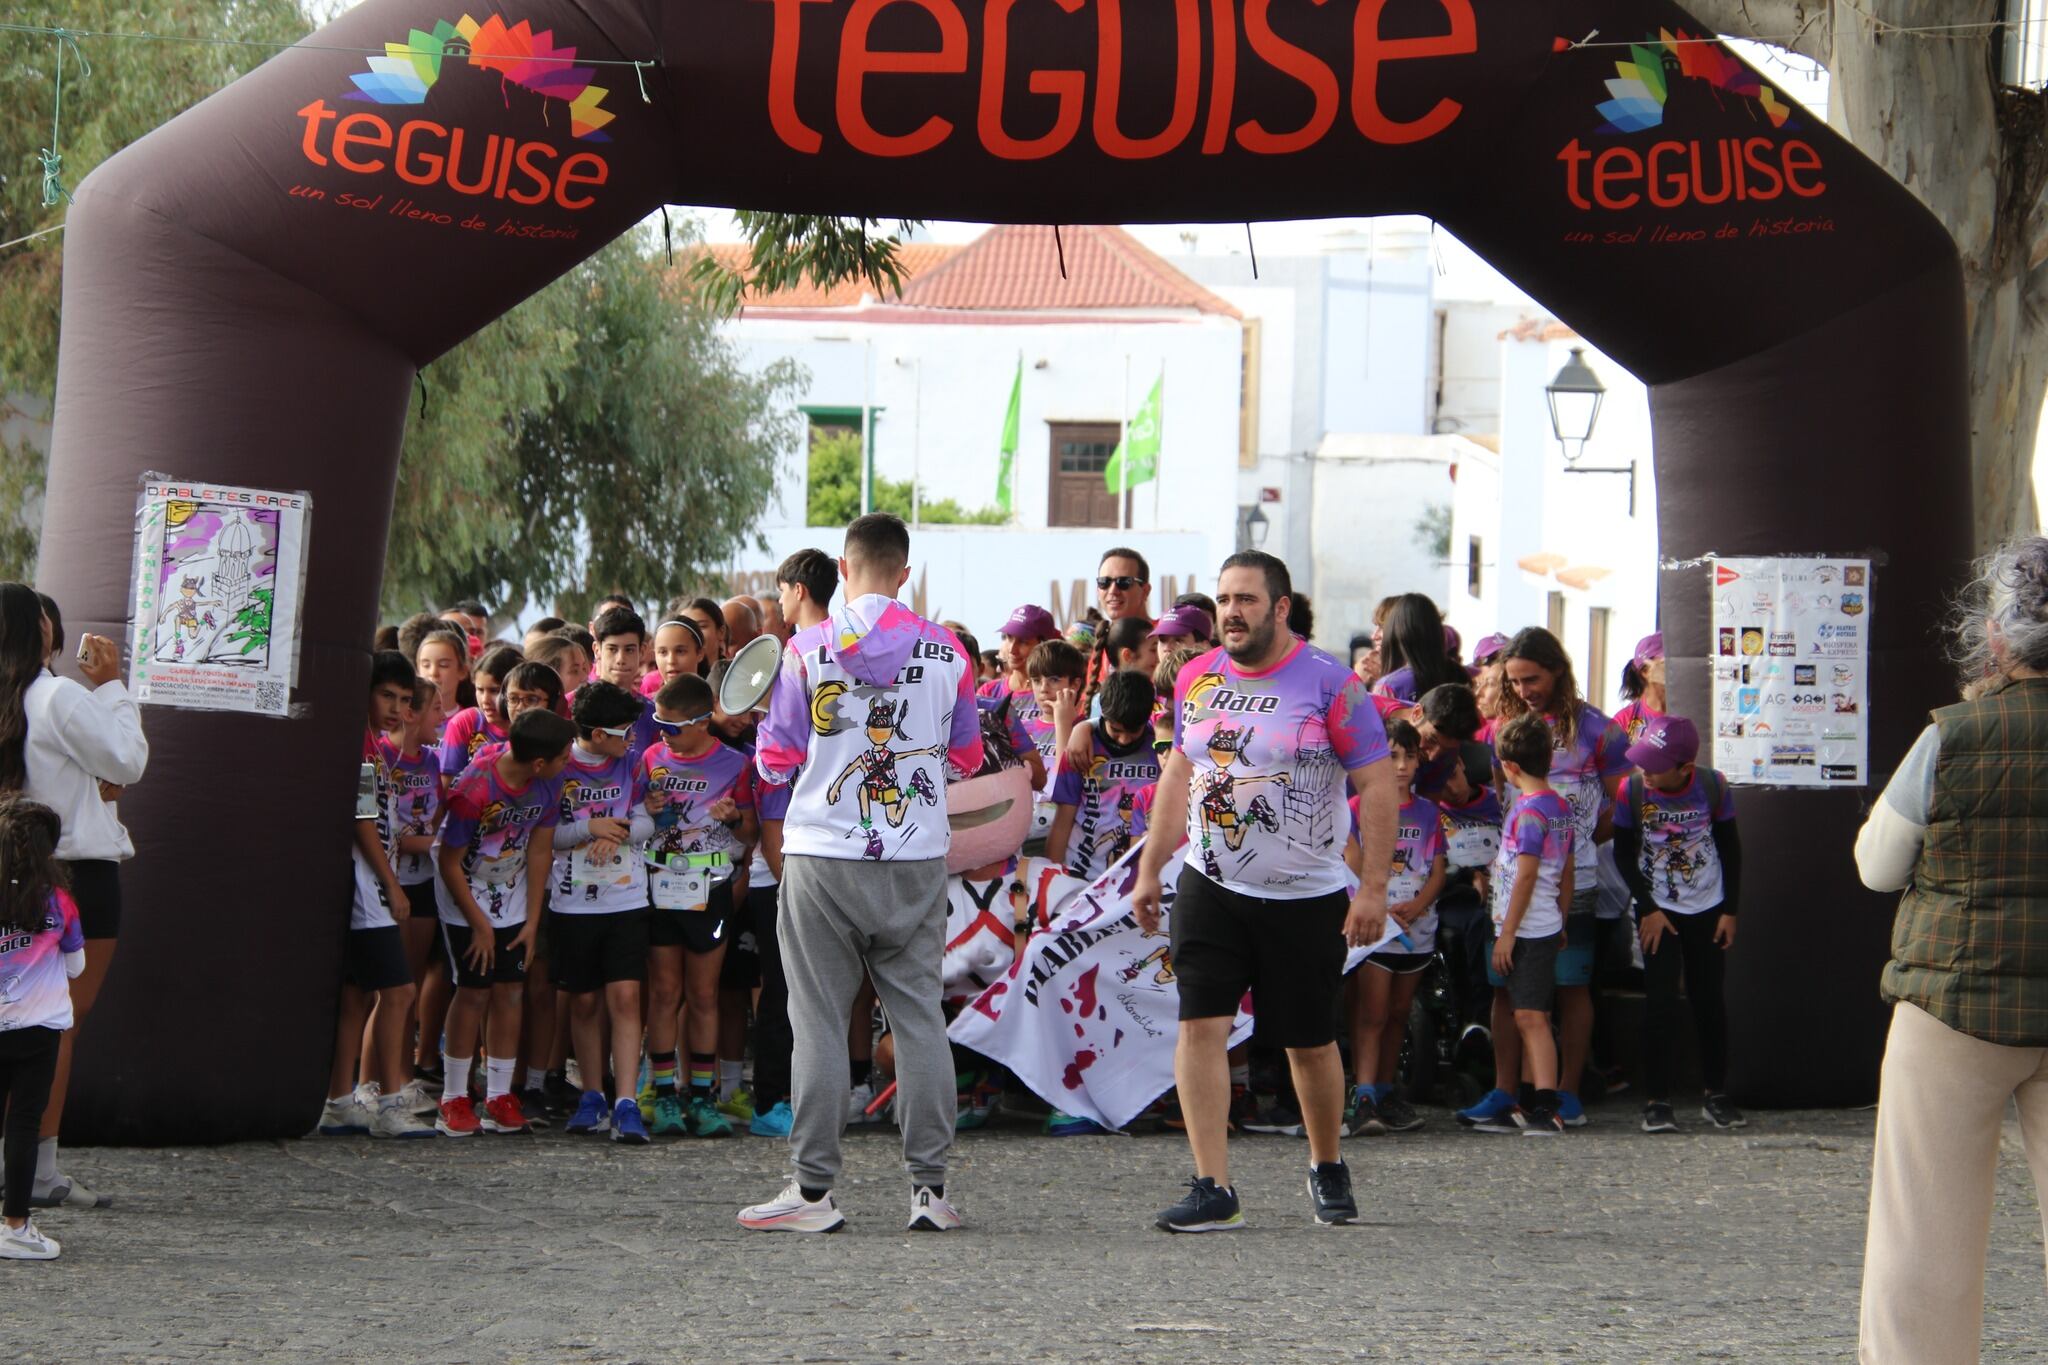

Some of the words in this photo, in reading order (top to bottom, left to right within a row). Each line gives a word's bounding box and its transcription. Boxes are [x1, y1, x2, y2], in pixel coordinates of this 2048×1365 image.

[289, 183, 325, 200] un
[335, 193, 384, 210] sol
[389, 199, 453, 225] lleno
[460, 214, 486, 231] de
[495, 218, 580, 240] historia
[1564, 231, 1594, 242] un
[1602, 226, 1643, 243] sol
[1649, 224, 1706, 243] lleno
[1714, 221, 1738, 239] de
[1748, 215, 1836, 236] historia
[147, 486, 251, 503] DIABLETES
[255, 495, 302, 510] RACE
[141, 545, 157, 610] ENERO
[1210, 689, 1280, 713] Race
[404, 774, 432, 788] Race
[1109, 763, 1158, 779] Race
[579, 787, 621, 802] Race
[664, 776, 708, 792] Race
